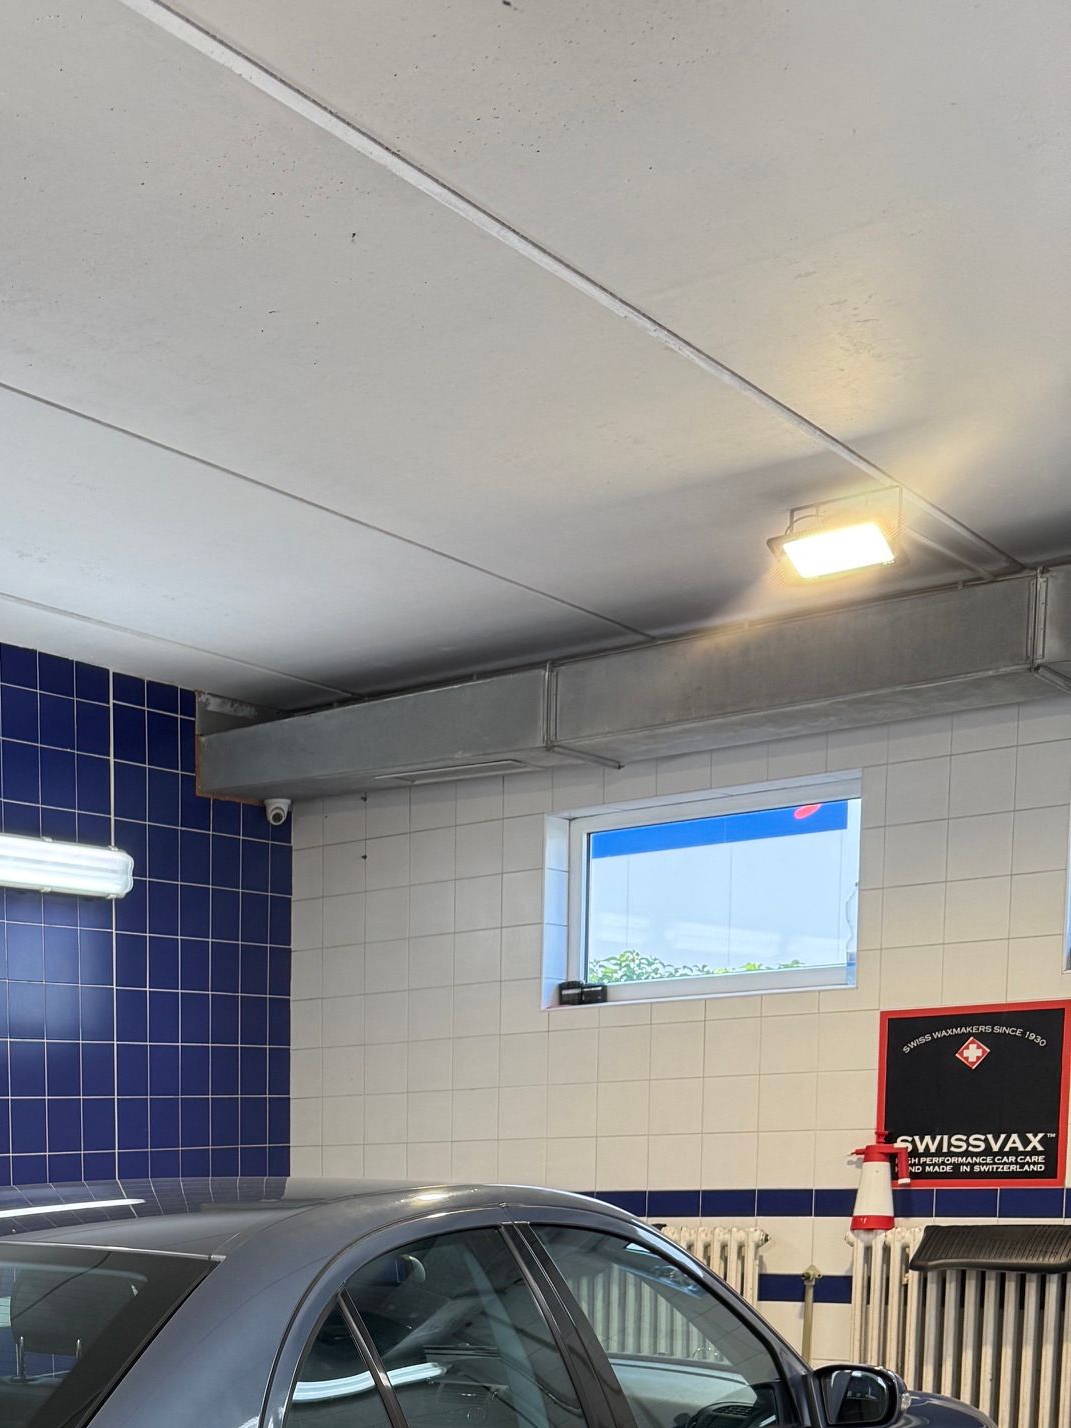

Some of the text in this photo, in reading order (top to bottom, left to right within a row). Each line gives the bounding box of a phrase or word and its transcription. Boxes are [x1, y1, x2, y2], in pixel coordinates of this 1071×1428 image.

[903, 1025, 1047, 1054] SWISS WAXMAKERS SINCE 1930
[920, 1156, 994, 1164] PERFORMANCE
[1017, 1155, 1045, 1163] CARE
[925, 1165, 953, 1173] MADE
[973, 1164, 1045, 1172] SWITZERLAND
